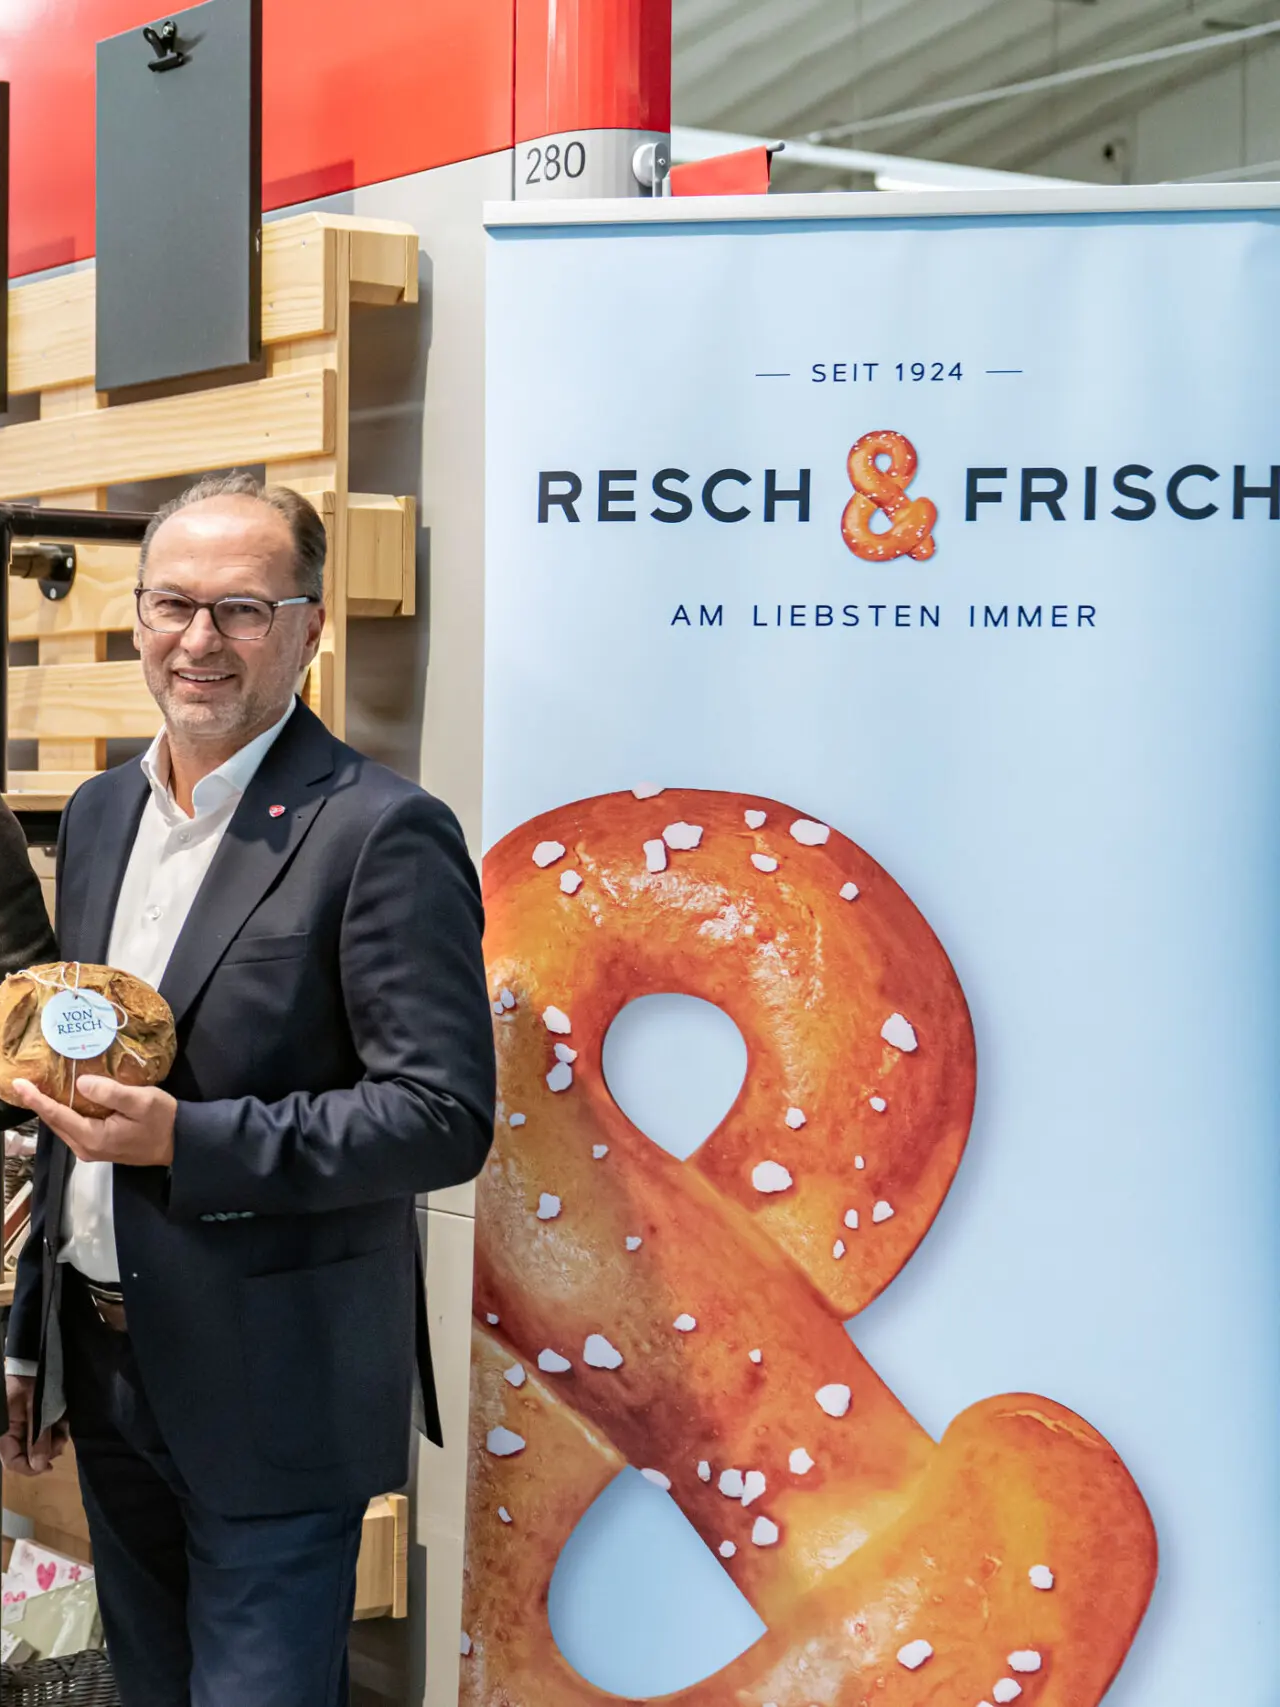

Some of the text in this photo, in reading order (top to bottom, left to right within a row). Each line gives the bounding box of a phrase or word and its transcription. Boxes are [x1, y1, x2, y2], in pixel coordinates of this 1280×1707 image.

[526, 141, 586, 185] 280
[811, 362, 963, 383] SEIT 1924
[537, 430, 1280, 563] RESCH & FRISCH
[670, 604, 1097, 628] AM LIEBSTEN IMMER
[62, 1009, 93, 1022] VON
[57, 1019, 102, 1035] RESCH
